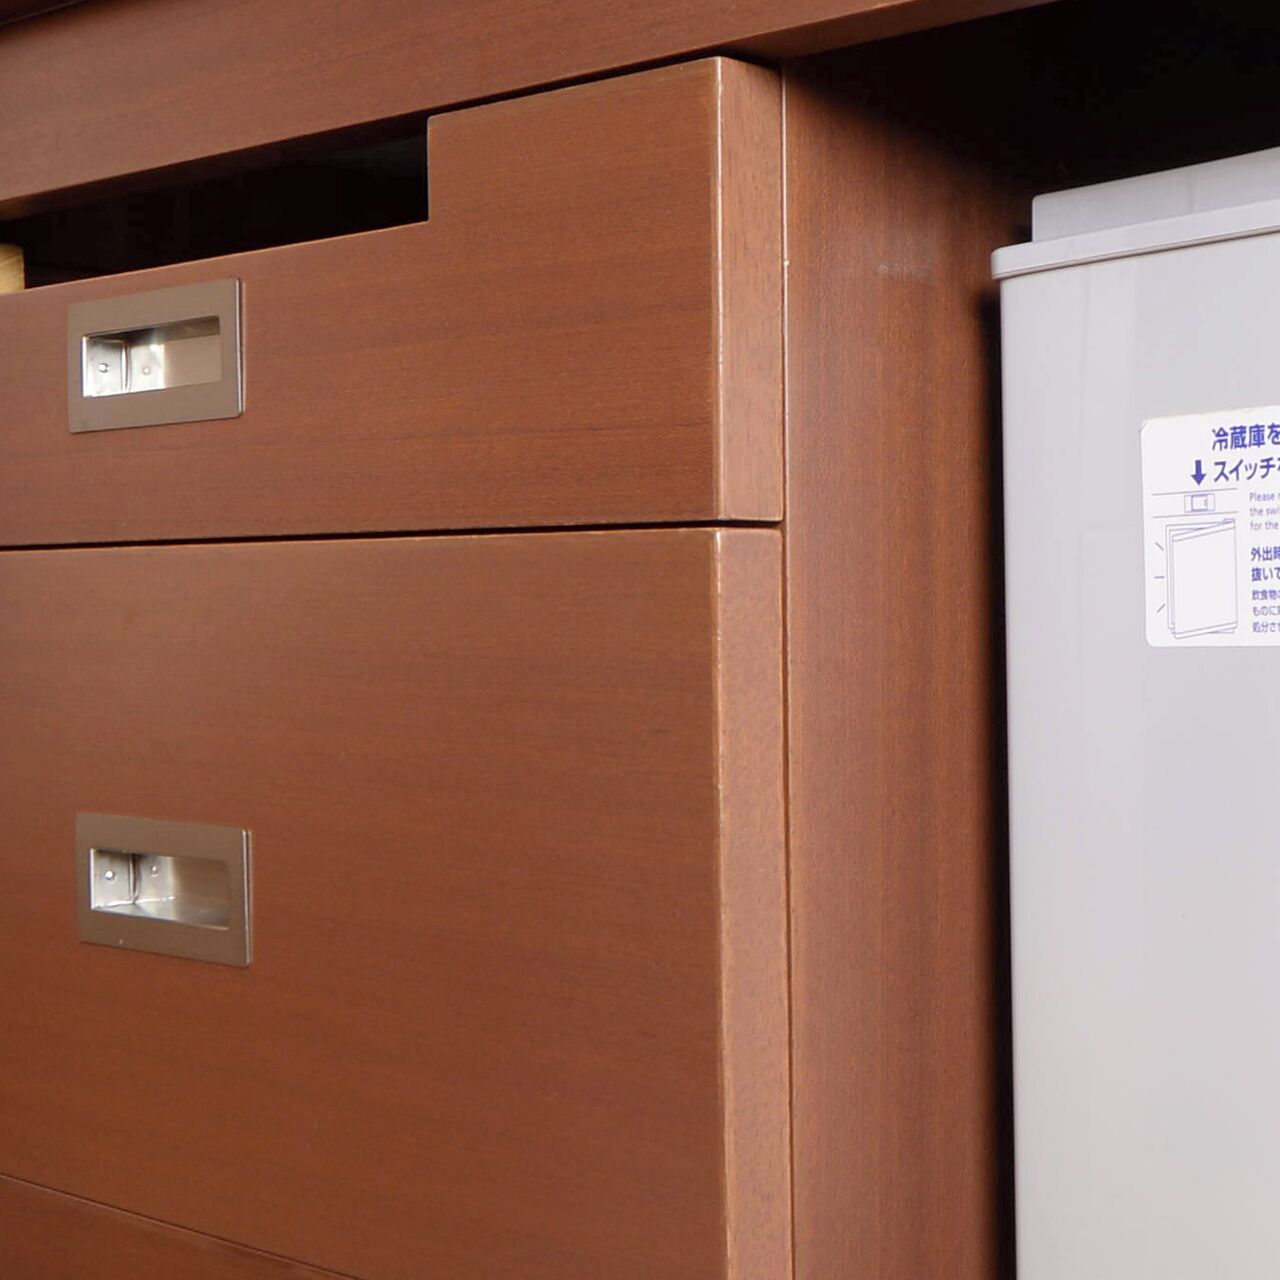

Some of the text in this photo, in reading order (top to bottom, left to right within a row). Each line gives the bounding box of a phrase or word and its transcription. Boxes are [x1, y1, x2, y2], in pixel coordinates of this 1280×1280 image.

[1250, 492, 1275, 502] Please
[1250, 506, 1264, 517] the
[1250, 520, 1263, 531] for
[1265, 519, 1279, 530] the
